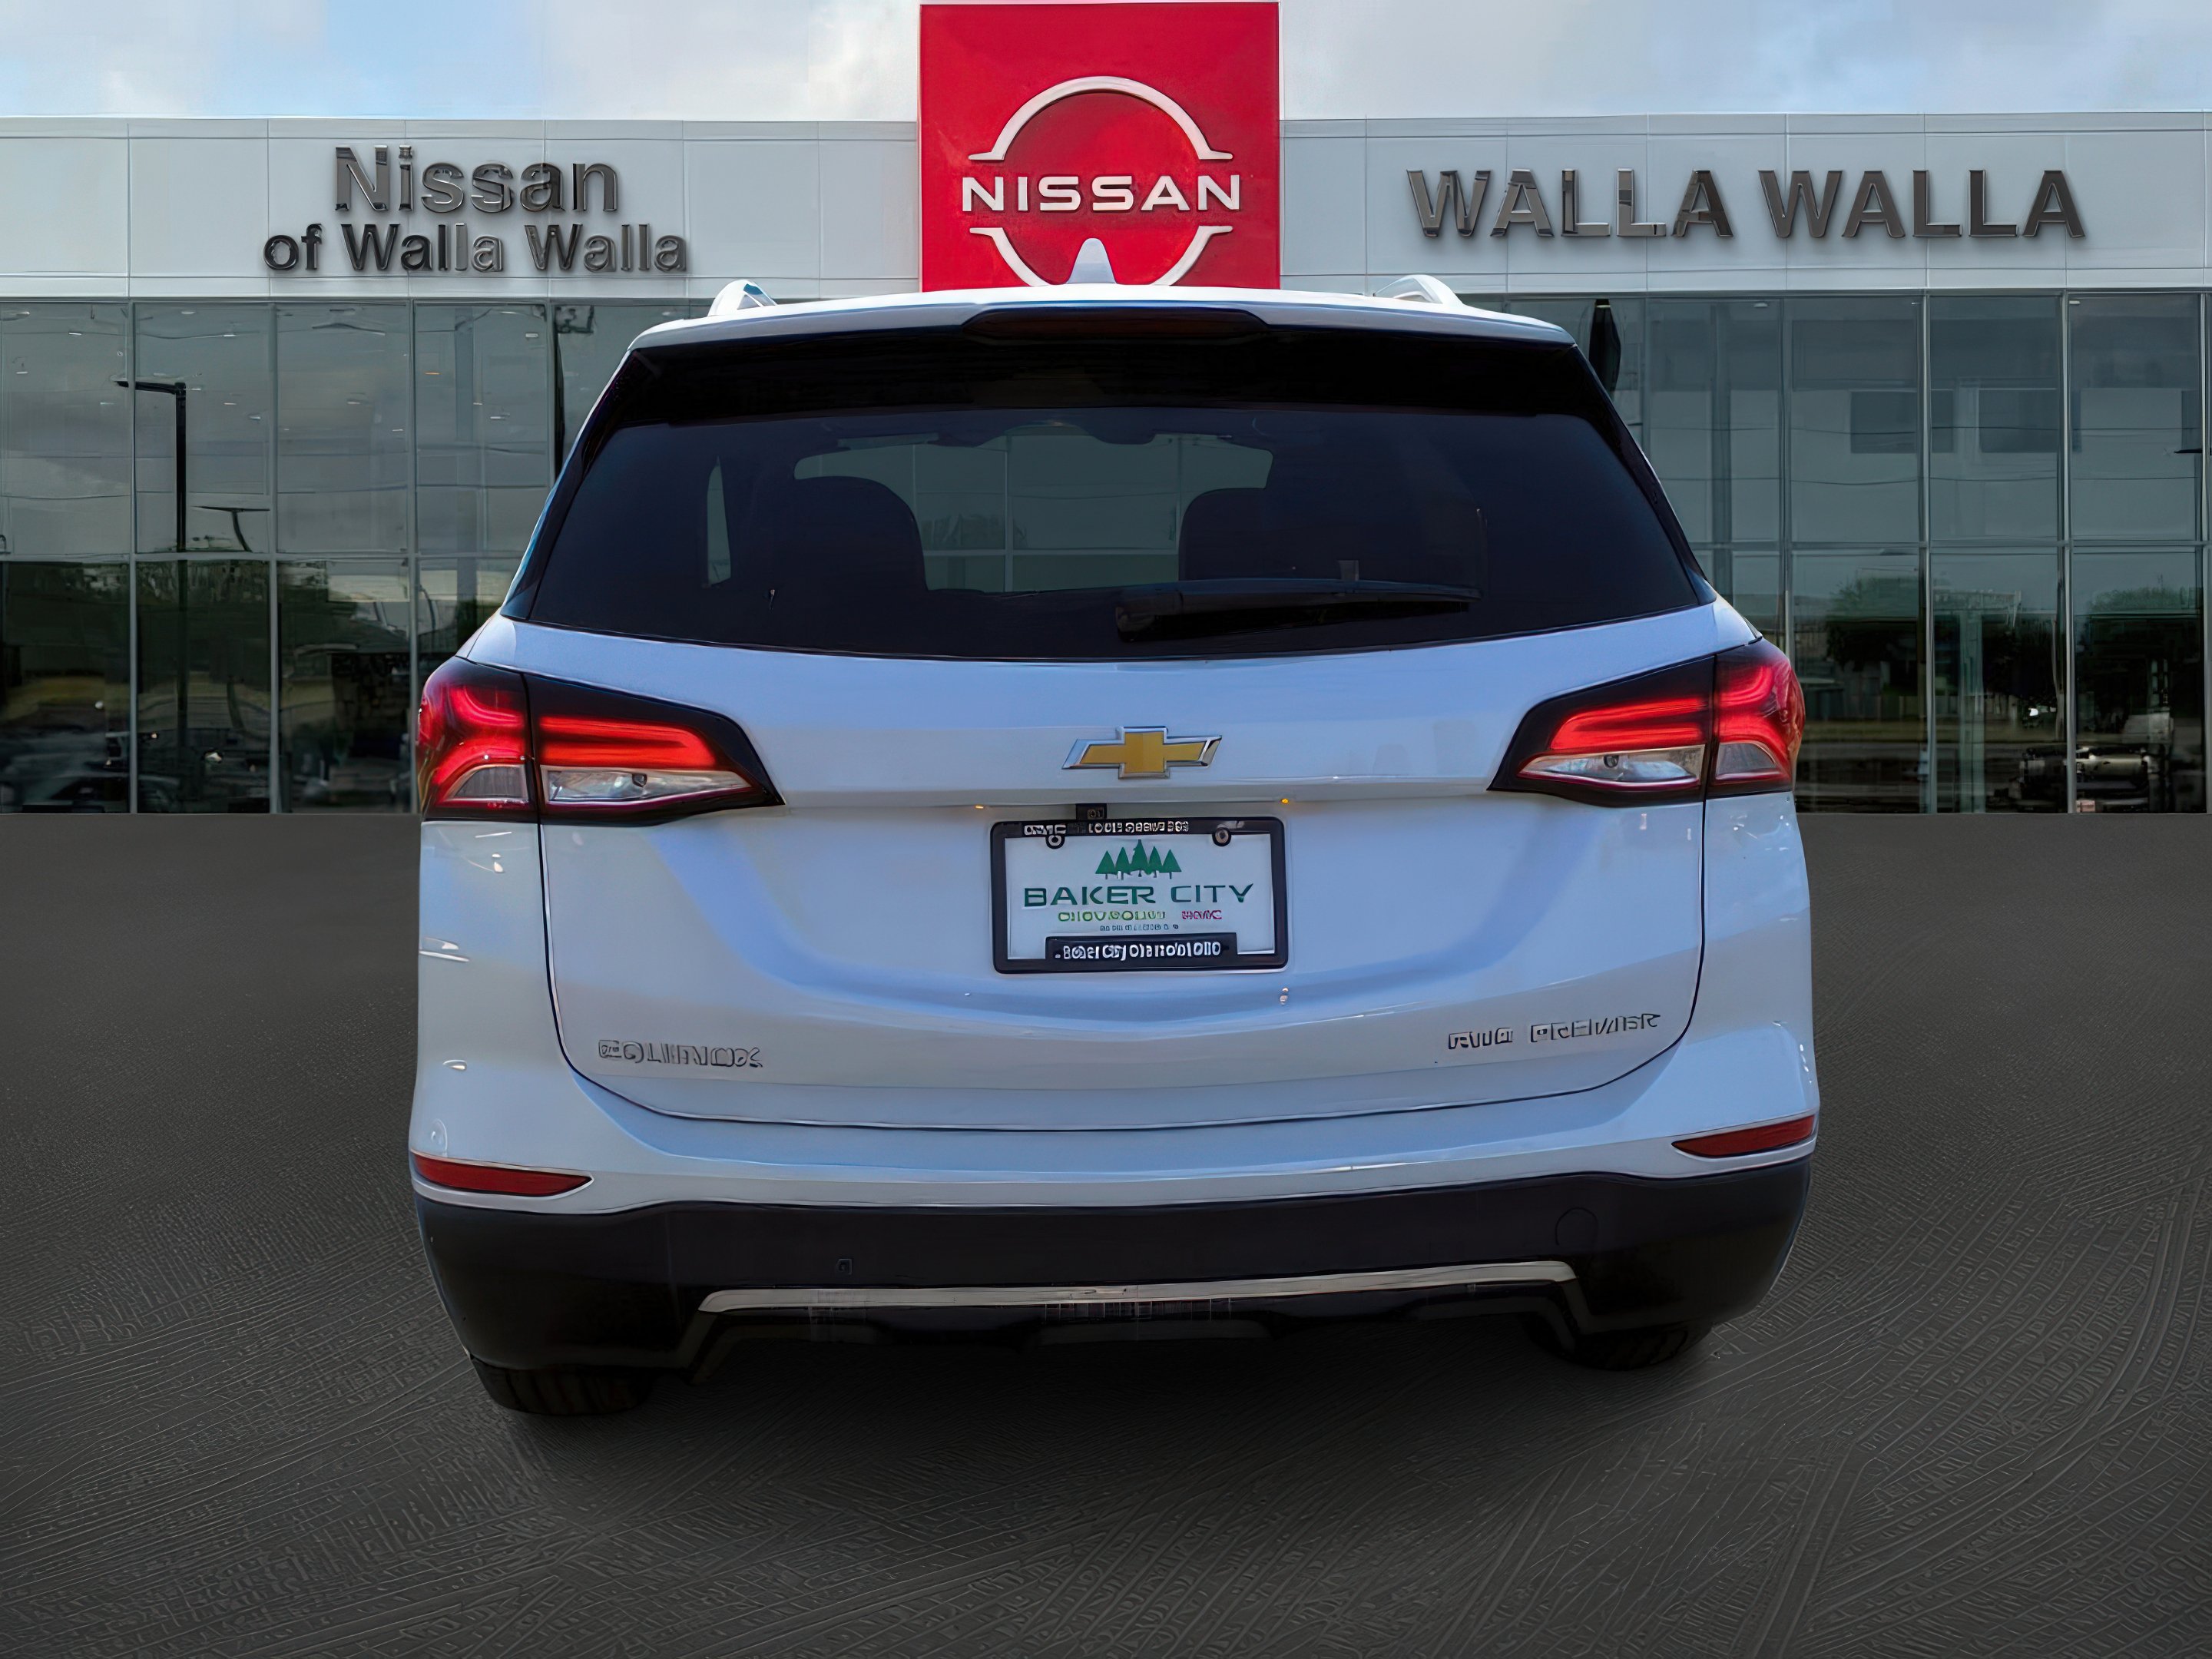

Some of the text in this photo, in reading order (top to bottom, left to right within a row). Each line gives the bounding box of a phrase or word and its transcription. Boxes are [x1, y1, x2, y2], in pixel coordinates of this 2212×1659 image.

[335, 144, 620, 213] Nissan
[962, 175, 1240, 212] NISSAN
[1406, 168, 2087, 238] WALLA WALLA
[263, 223, 687, 272] of Walla Walla
[1024, 882, 1254, 907] BAKER CITY
